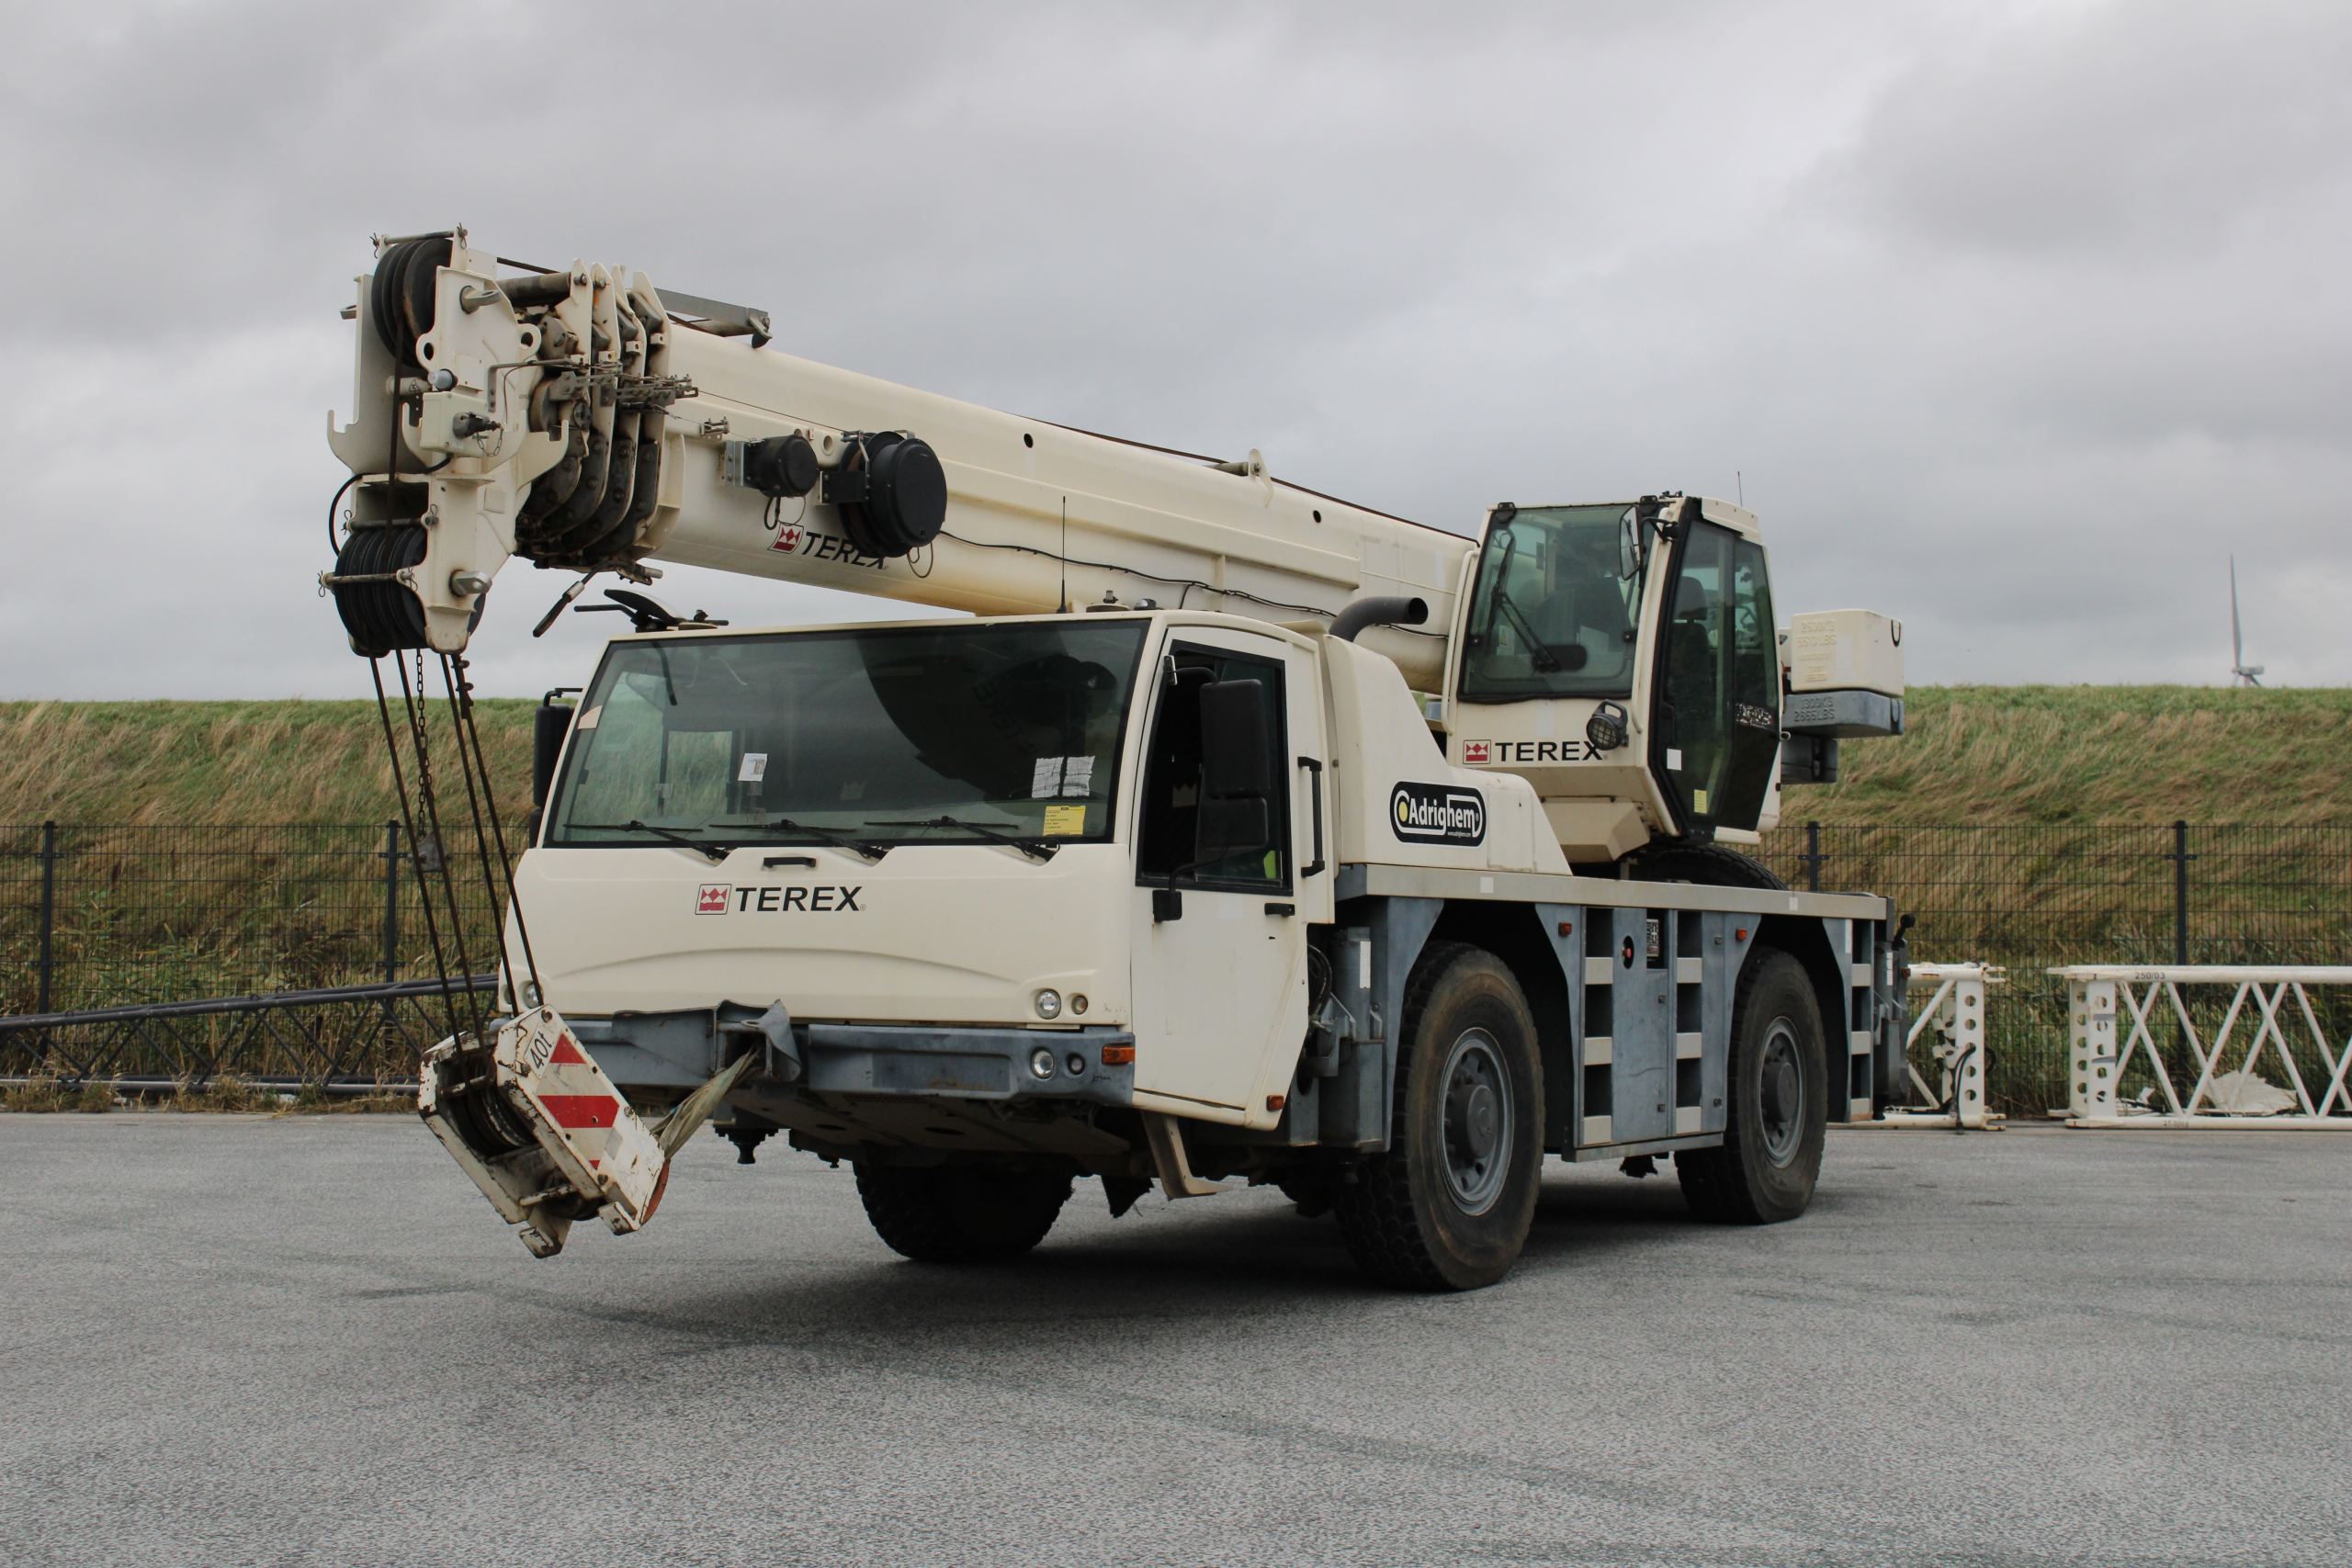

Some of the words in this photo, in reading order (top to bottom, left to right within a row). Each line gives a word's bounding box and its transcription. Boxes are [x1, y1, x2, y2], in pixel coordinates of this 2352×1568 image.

[1495, 740, 1603, 762] TEREX
[1408, 794, 1476, 836] Adrighem
[735, 886, 863, 912] TEREX
[2134, 972, 2165, 980] 250/03
[530, 1031, 553, 1069] 40t
